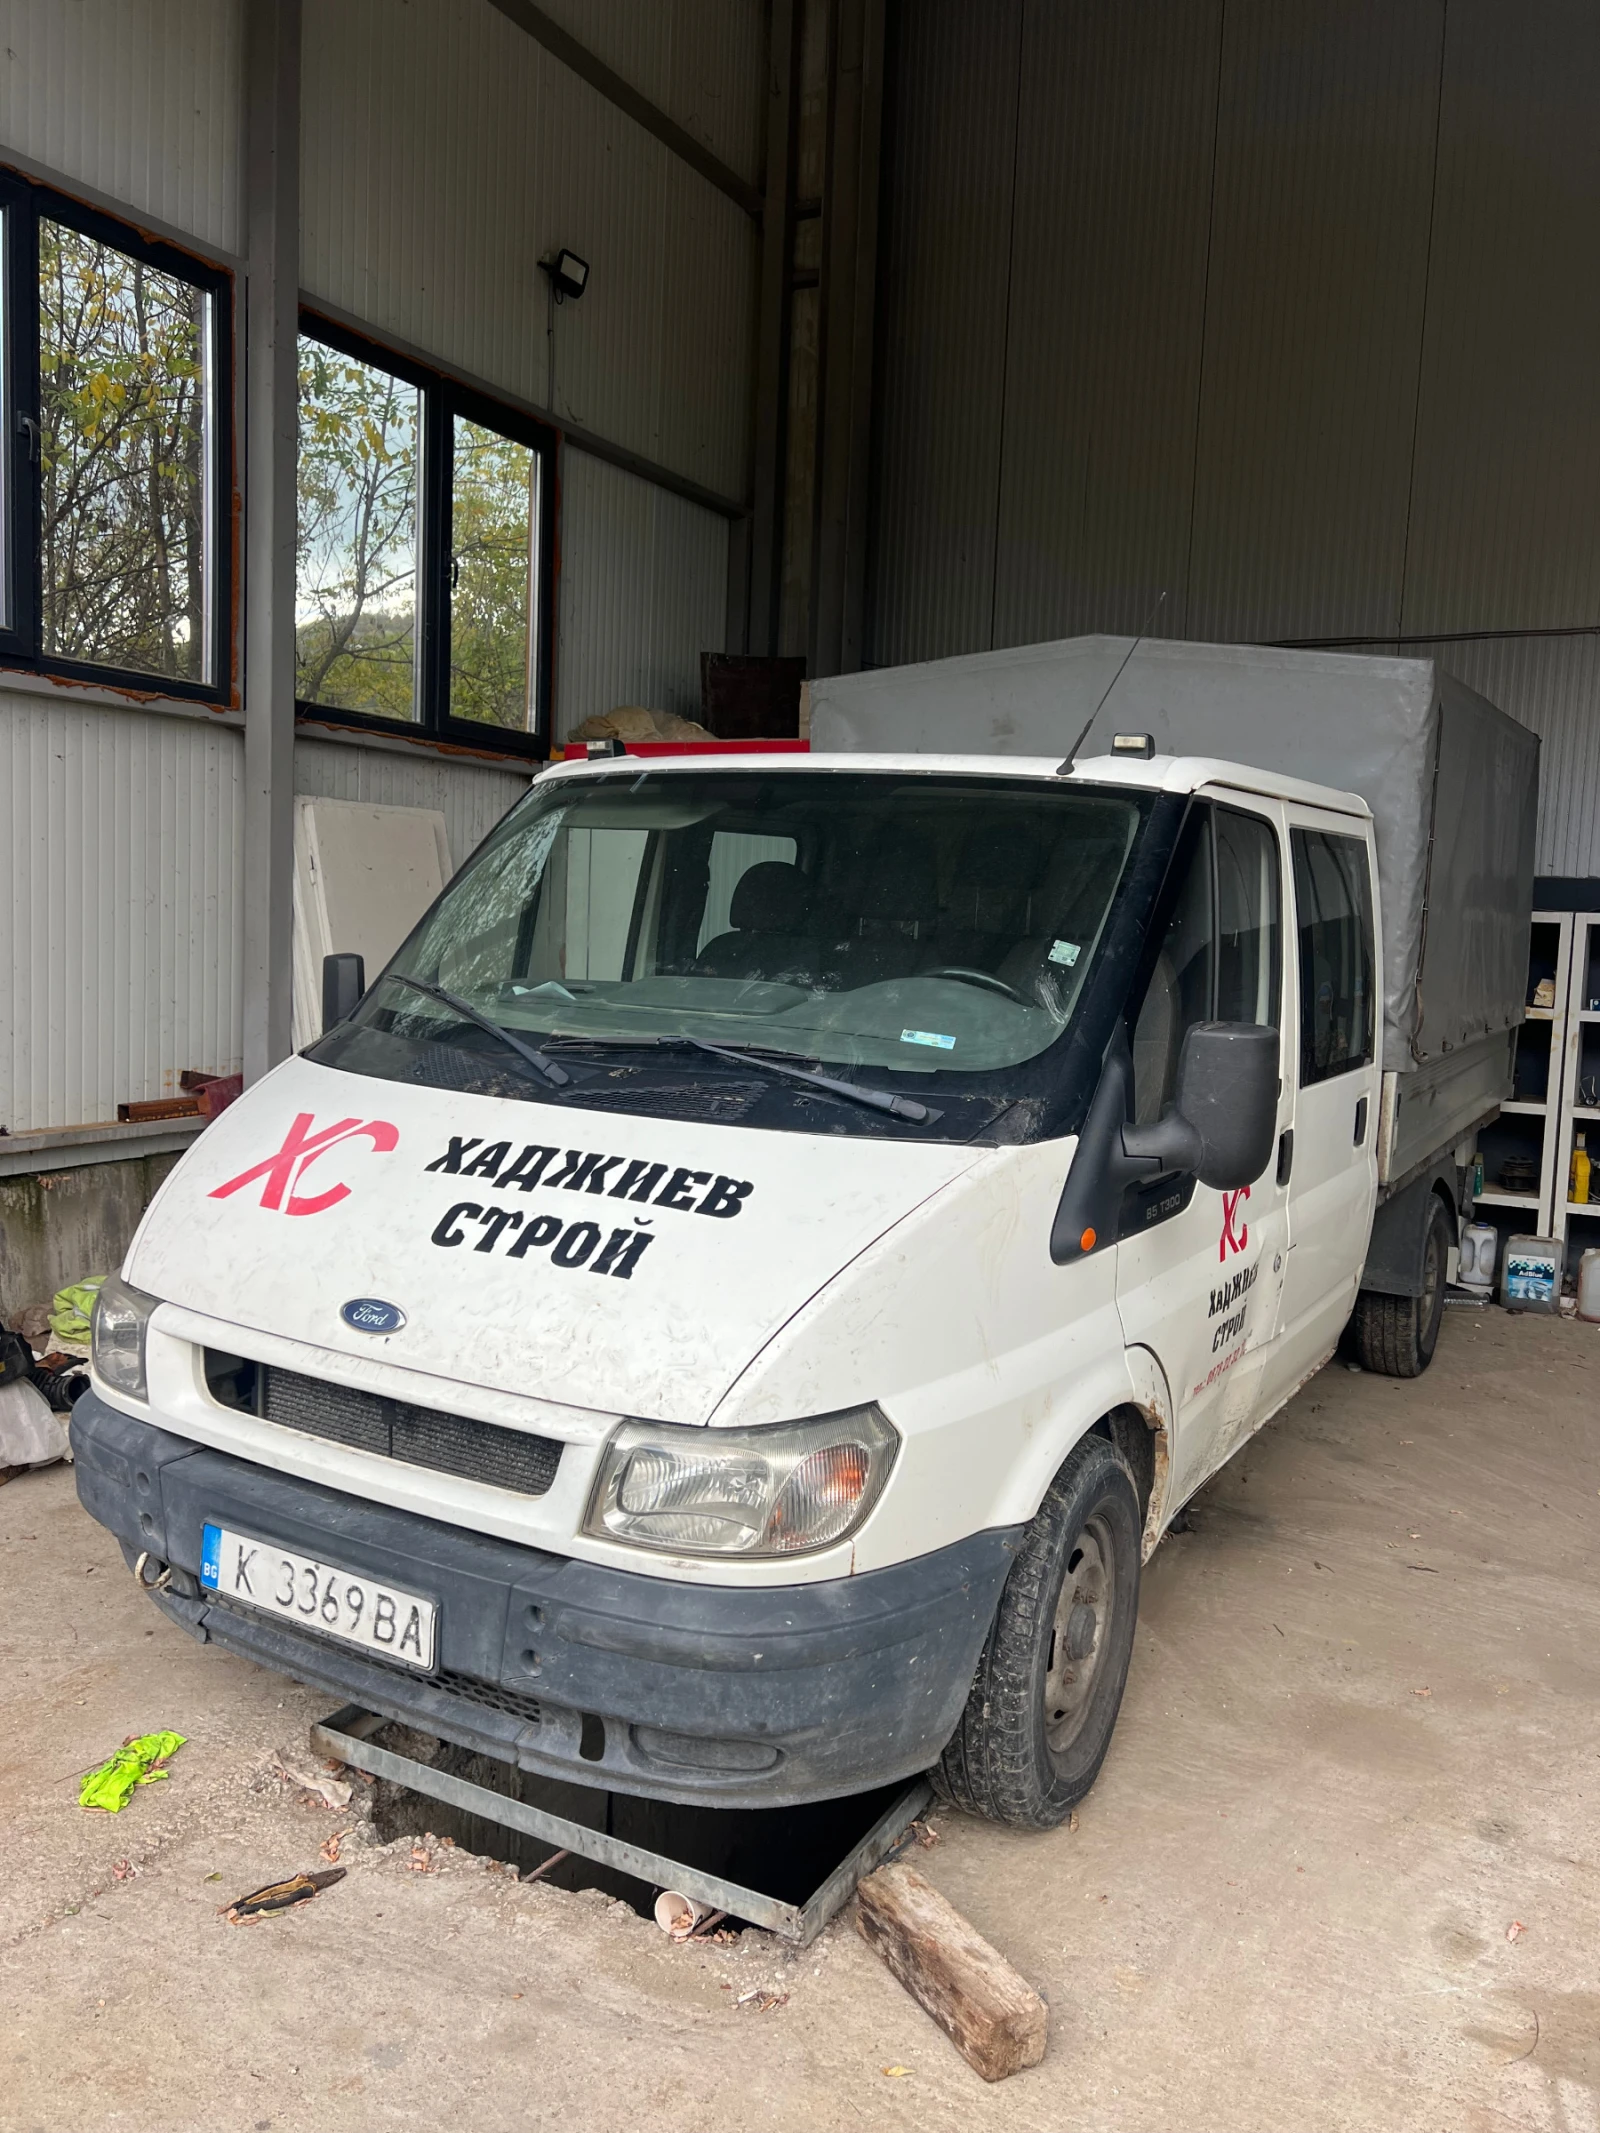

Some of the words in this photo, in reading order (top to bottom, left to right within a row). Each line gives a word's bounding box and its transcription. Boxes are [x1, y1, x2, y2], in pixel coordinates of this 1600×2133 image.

[423, 1135, 755, 1219] ХАДЖИЕВ
[1160, 1193, 1181, 1213] T300
[430, 1201, 656, 1280] СТРОЙ
[352, 1303, 389, 1326] Ford
[203, 1561, 218, 1579] BG
[235, 1544, 258, 1596] K
